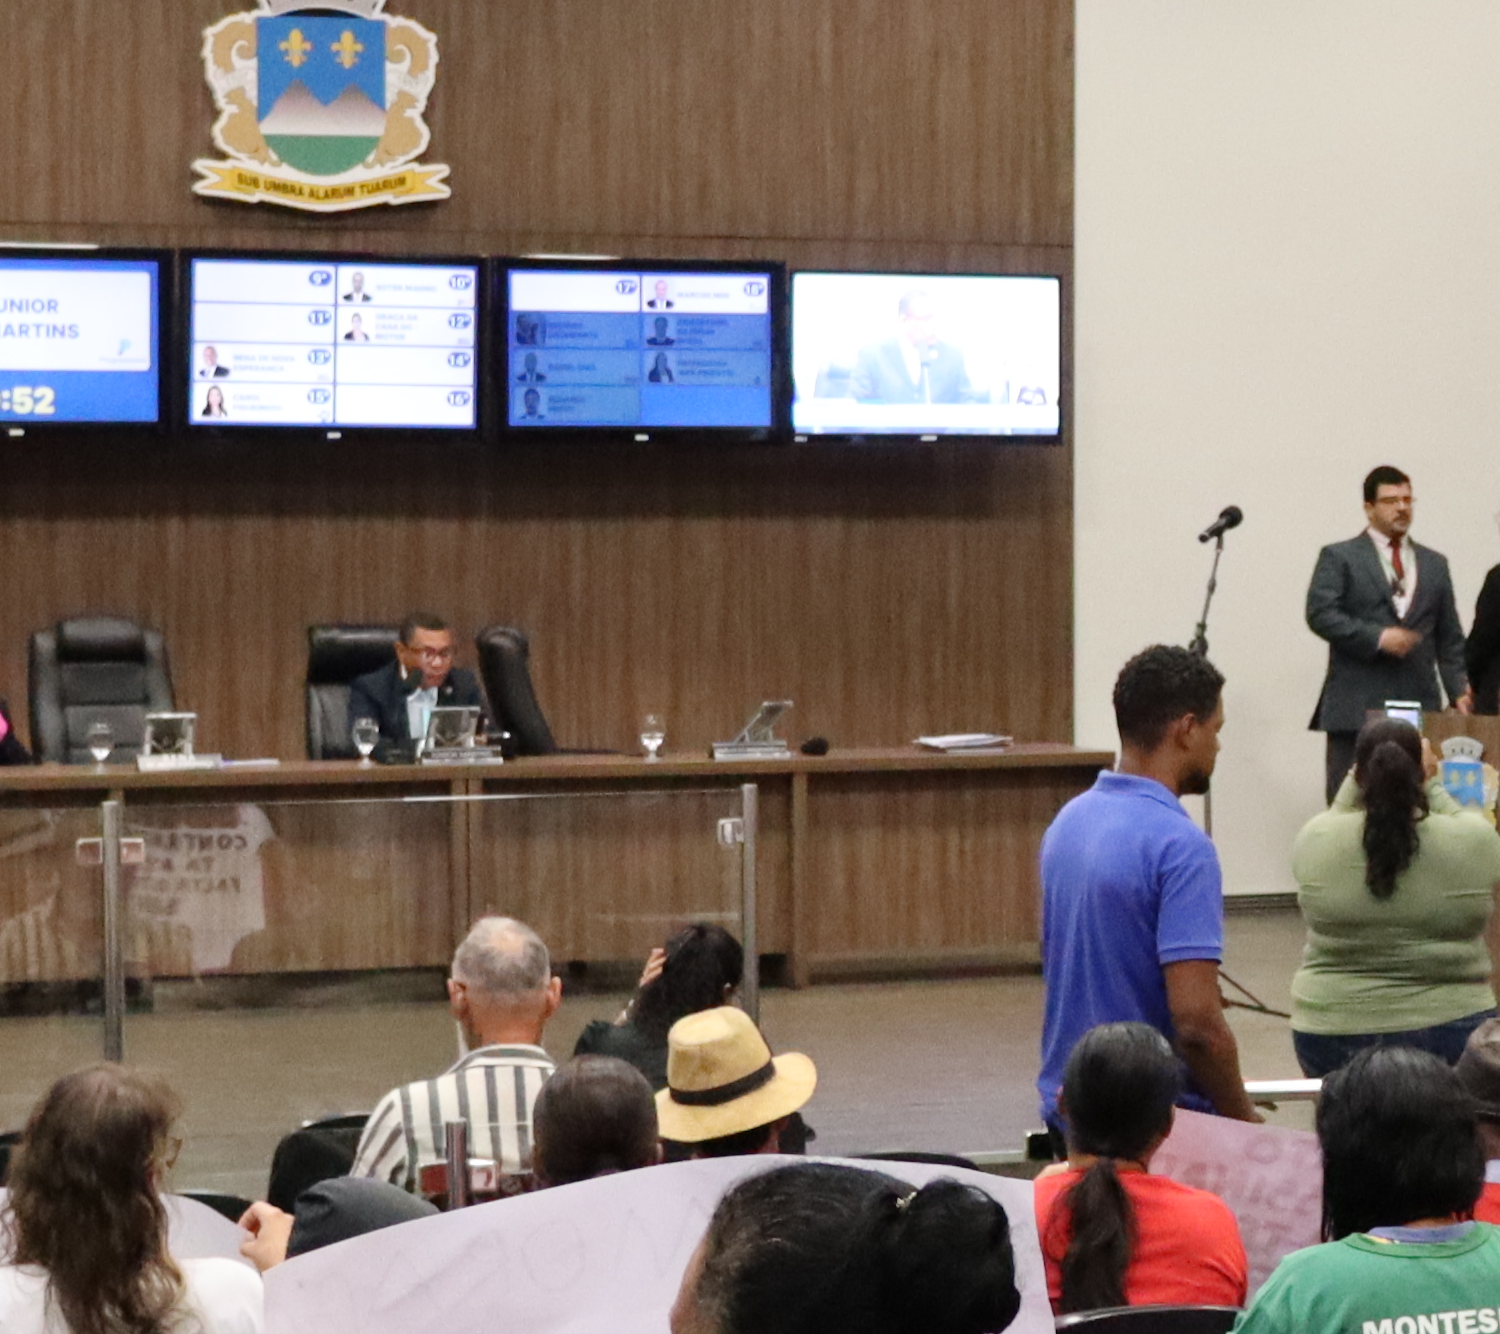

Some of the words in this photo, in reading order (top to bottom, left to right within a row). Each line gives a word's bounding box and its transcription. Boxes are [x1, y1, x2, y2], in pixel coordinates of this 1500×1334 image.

[236, 171, 261, 190] SUB
[263, 177, 304, 197] UMBRA
[308, 184, 355, 201] ALARUM
